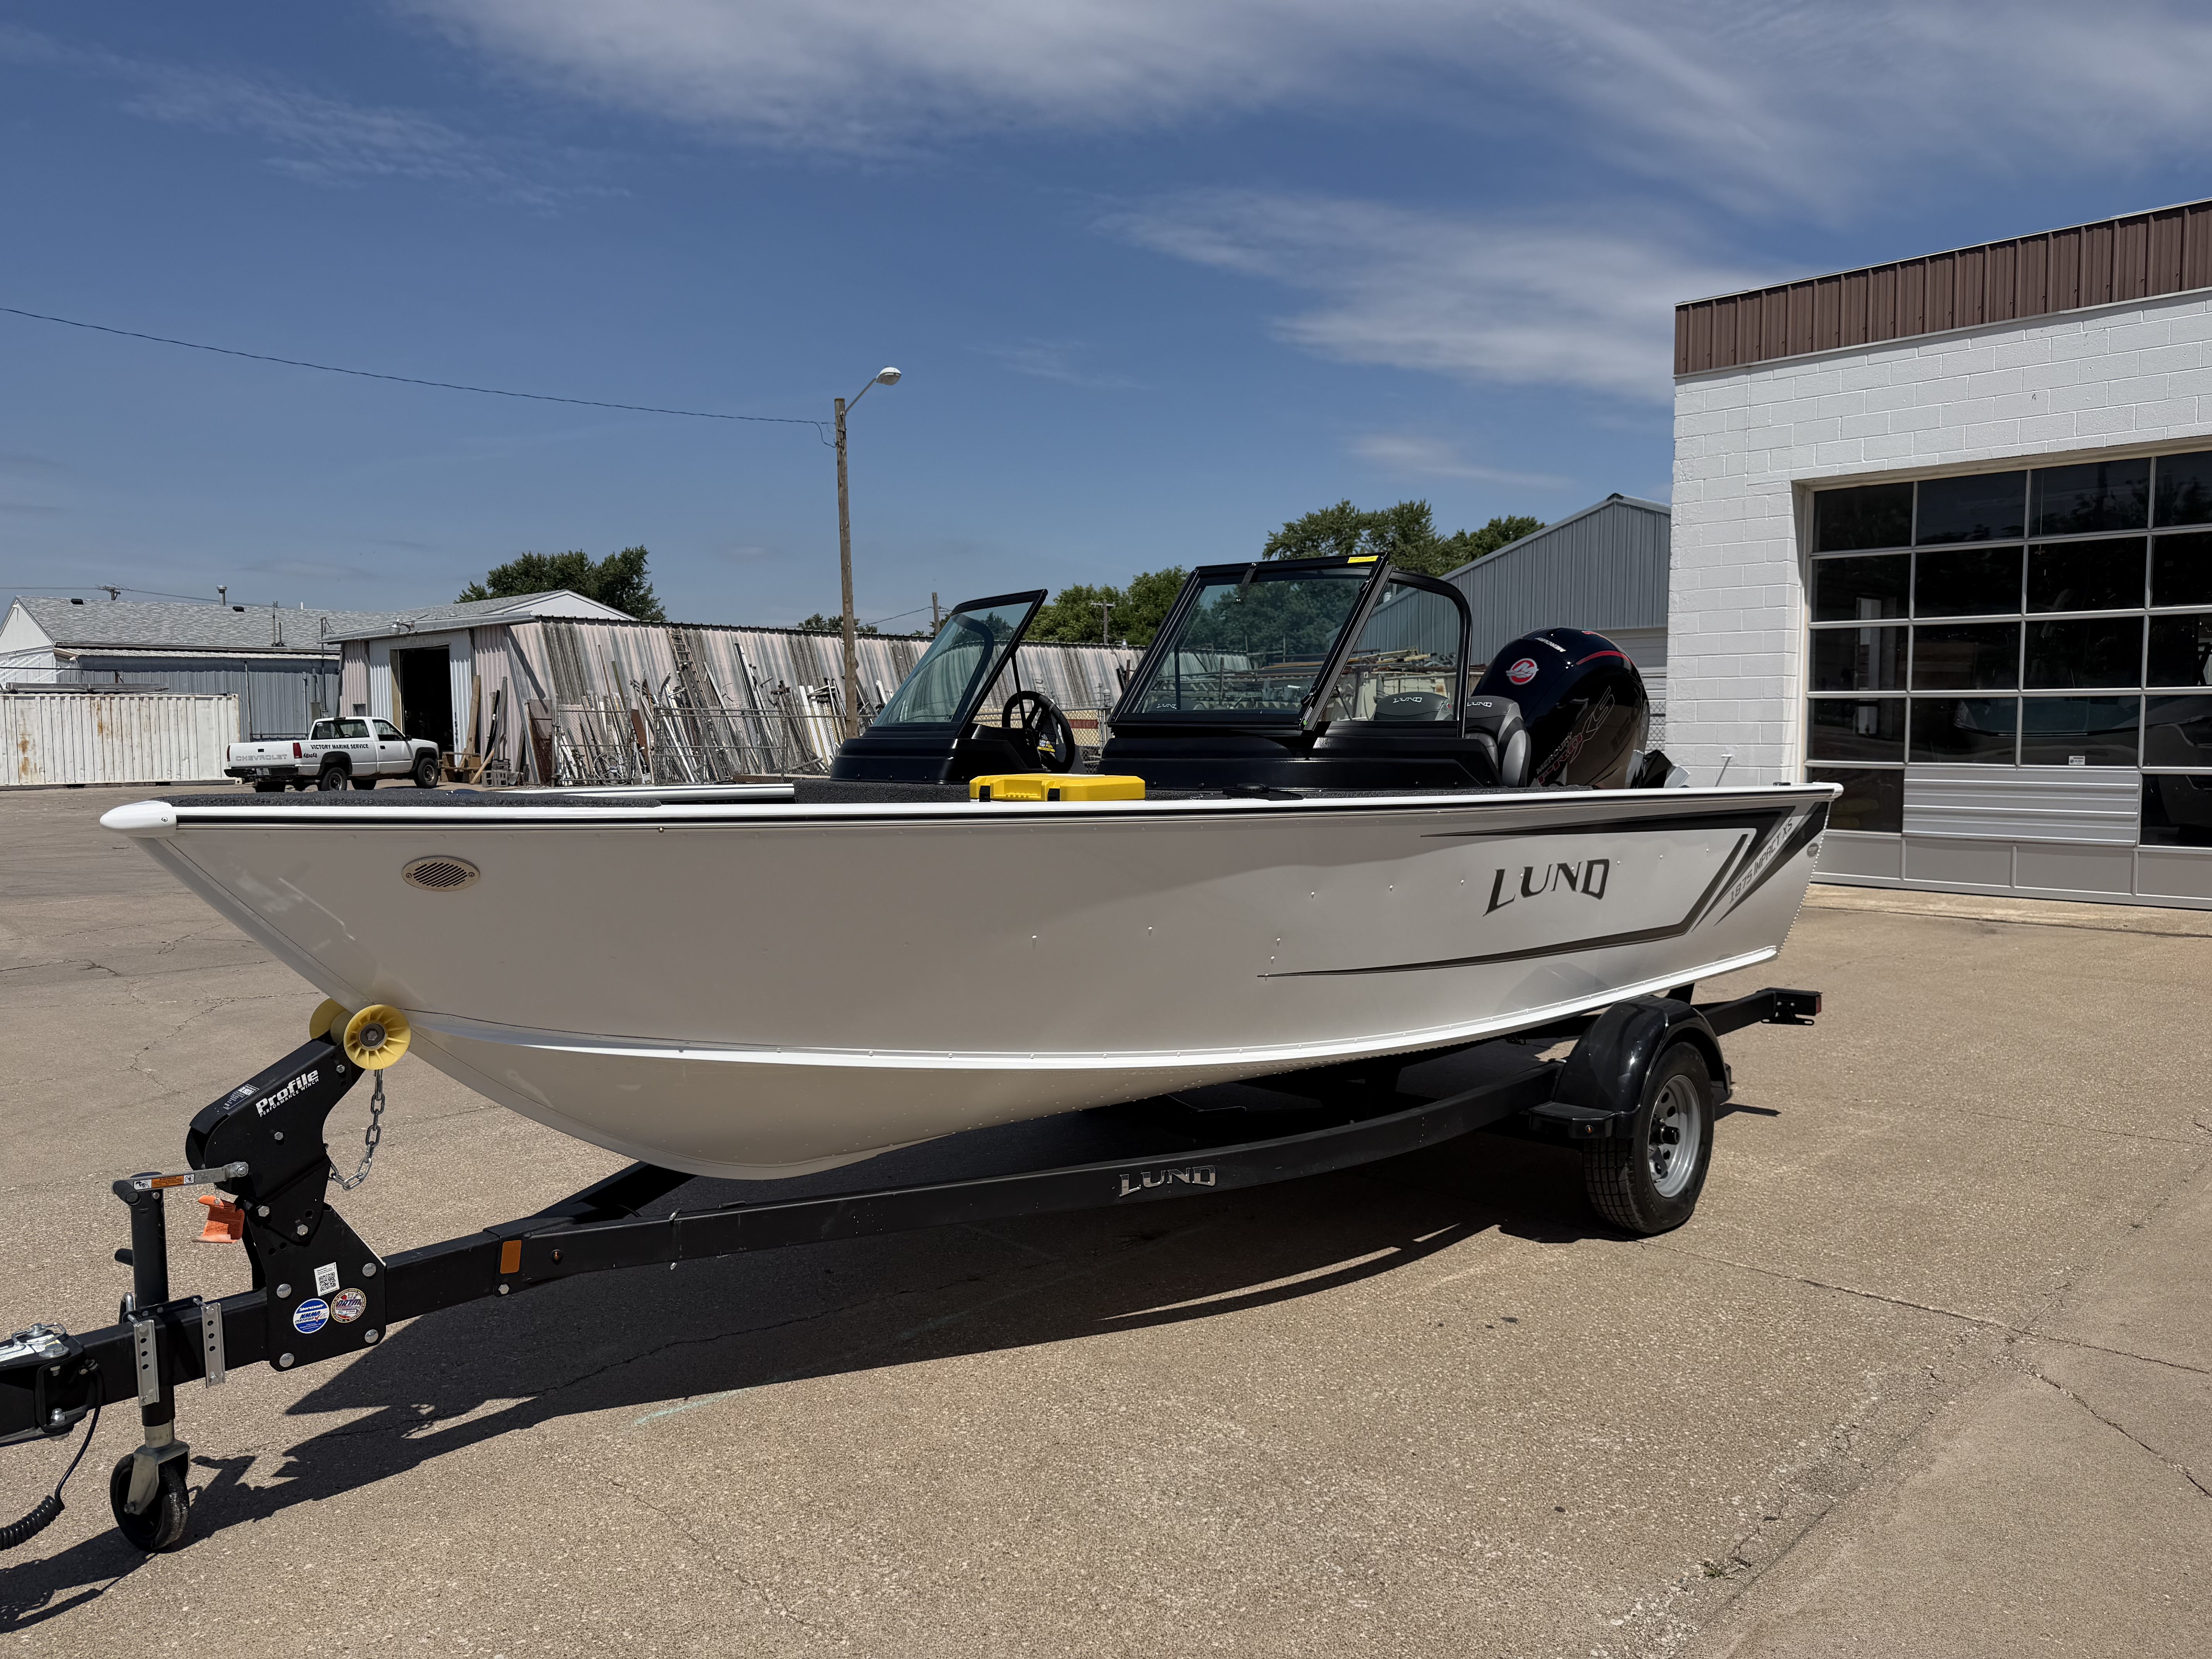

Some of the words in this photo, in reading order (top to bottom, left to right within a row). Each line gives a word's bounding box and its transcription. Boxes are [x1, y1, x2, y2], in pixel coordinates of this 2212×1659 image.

[1536, 732, 1572, 774] MERCURY
[1729, 869, 1752, 904] 1875
[1753, 832, 1781, 876] IMPACT
[1782, 817, 1793, 838] XS
[1482, 858, 1610, 917] LUND
[256, 1070, 319, 1114] Profile
[259, 1089, 299, 1118] PERFORMANCE
[301, 1078, 319, 1091] WINCH
[1119, 1165, 1216, 1198] LUND
